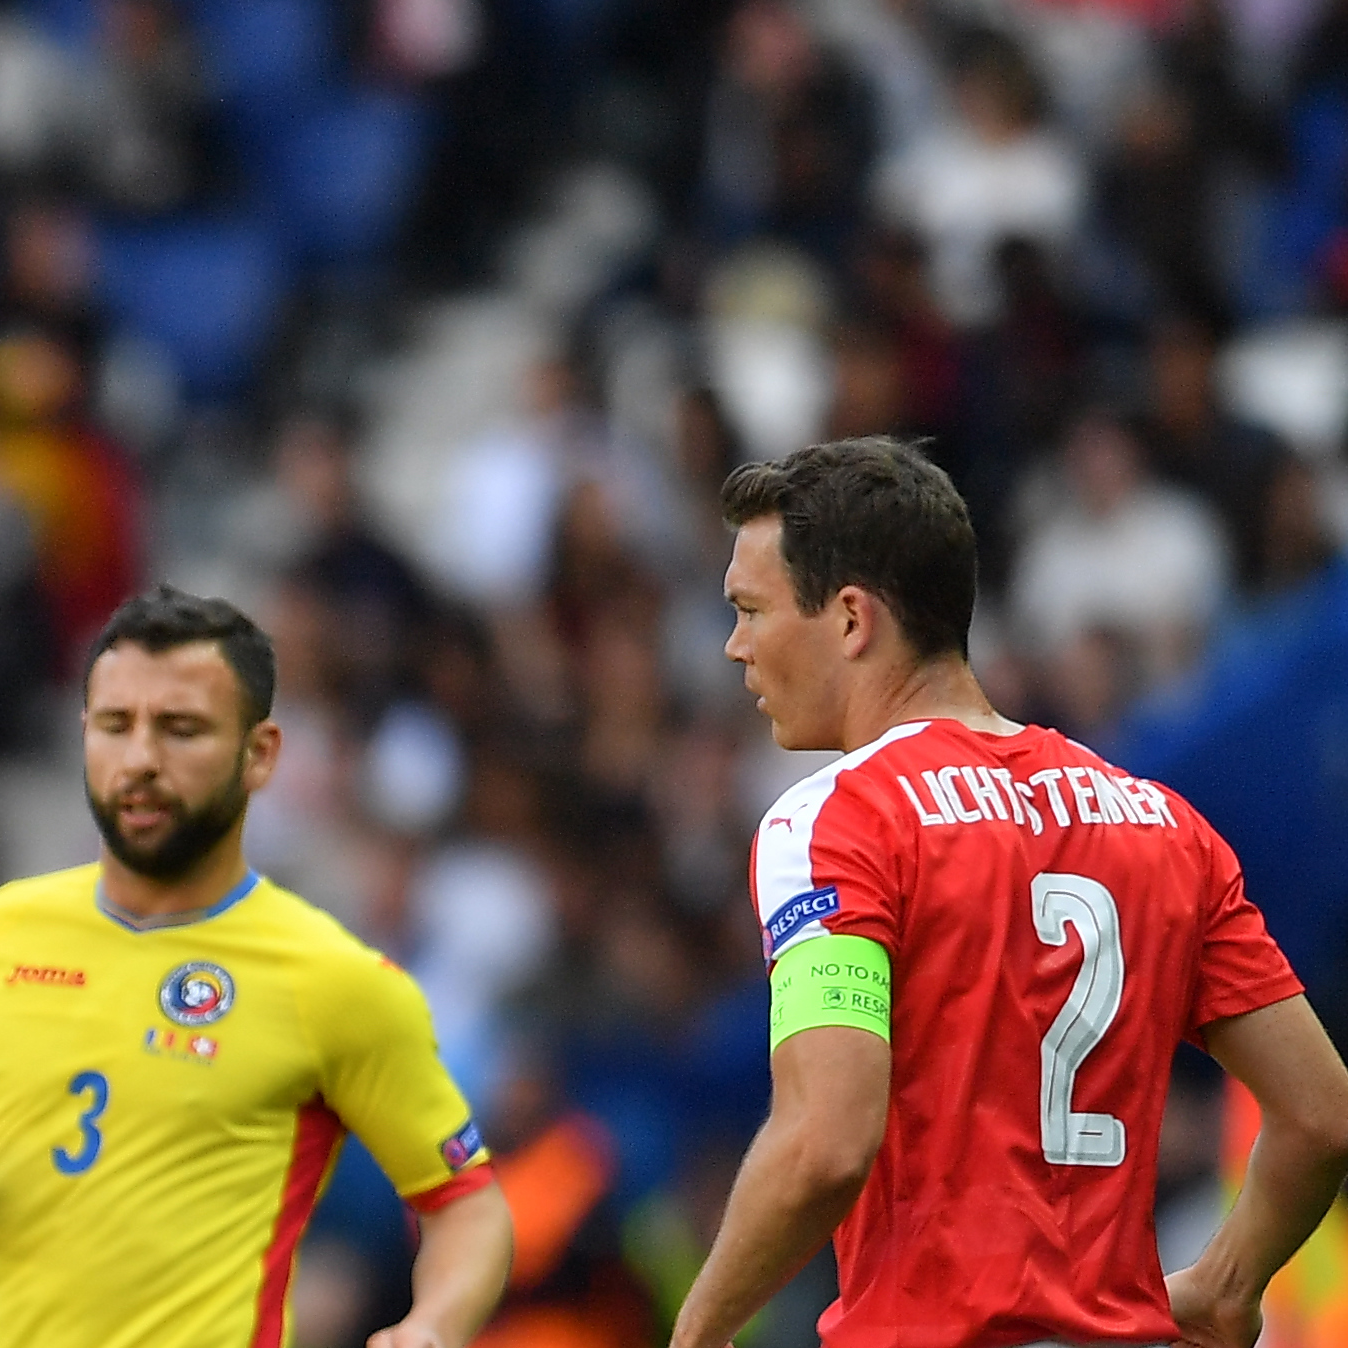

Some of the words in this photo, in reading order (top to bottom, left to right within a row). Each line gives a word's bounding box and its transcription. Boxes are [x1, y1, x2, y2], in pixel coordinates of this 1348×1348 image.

[770, 892, 837, 941] RESPECT
[811, 963, 840, 978] NO
[845, 964, 869, 980] TO
[1030, 871, 1127, 1167] 2
[50, 1069, 110, 1176] 3
